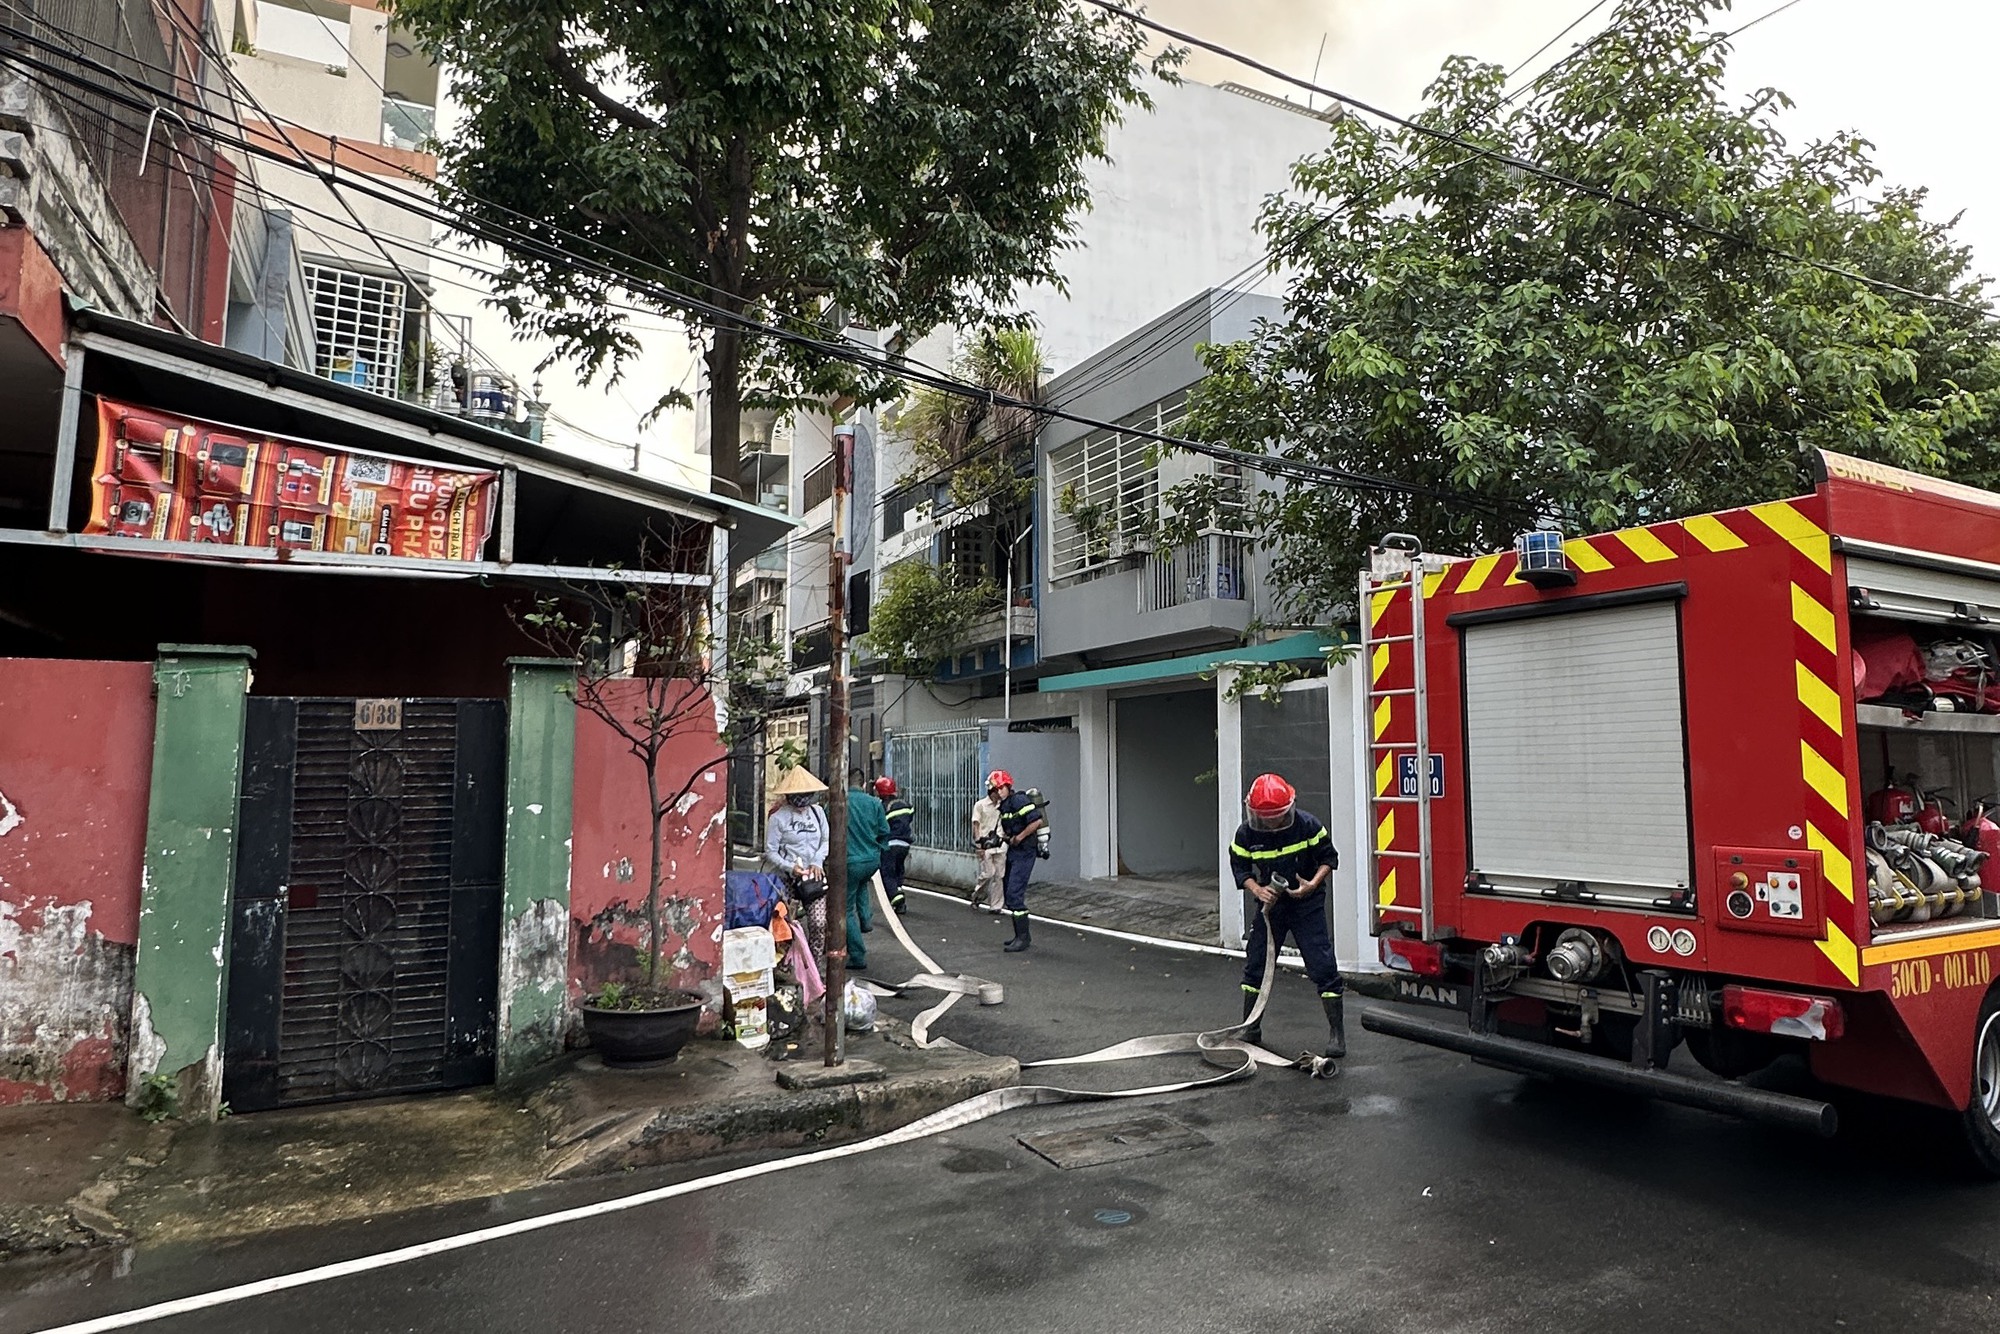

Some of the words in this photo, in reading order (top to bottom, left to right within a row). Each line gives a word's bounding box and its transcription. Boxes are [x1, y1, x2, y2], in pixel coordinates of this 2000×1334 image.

[361, 703, 397, 726] 6/38
[1891, 959, 1931, 999] 50CD
[1943, 950, 1990, 990] 001.10
[1400, 980, 1458, 1005] MAN
